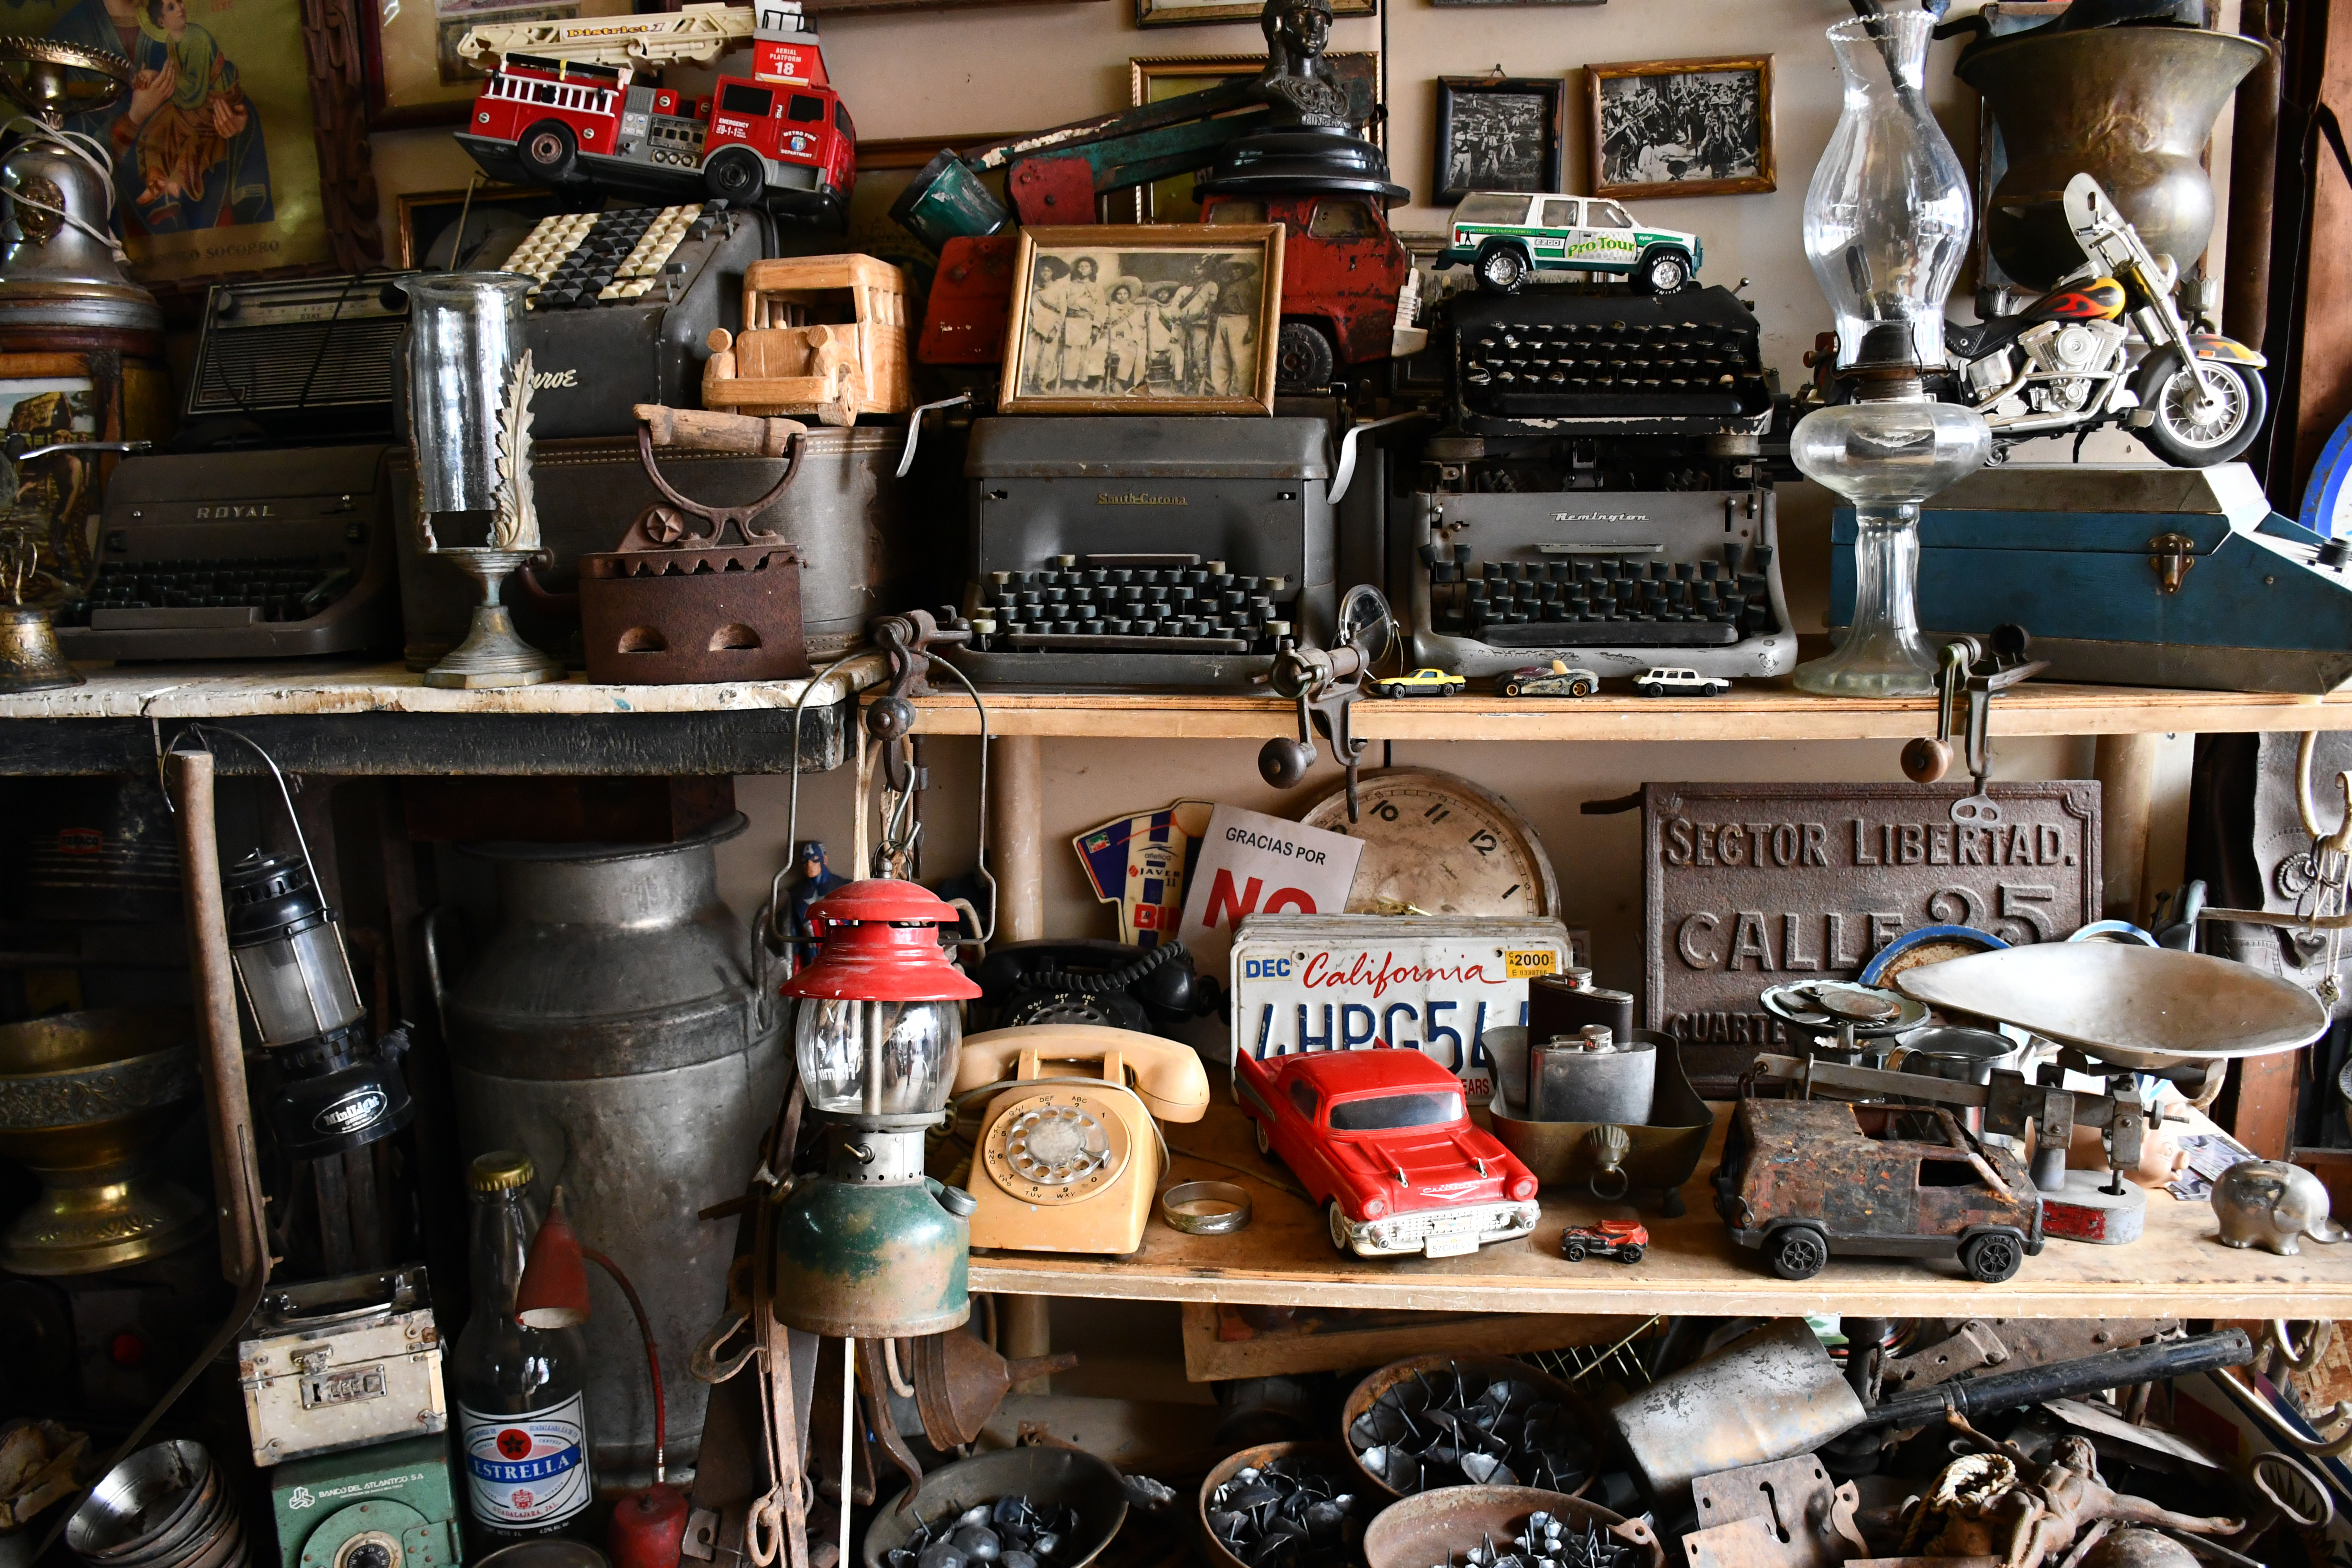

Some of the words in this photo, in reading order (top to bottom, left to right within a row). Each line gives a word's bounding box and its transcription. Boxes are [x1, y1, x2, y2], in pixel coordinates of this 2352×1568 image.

[568, 25, 648, 37] District
[651, 22, 665, 32] 1
[769, 53, 802, 63] PLATFORM
[776, 47, 797, 55] AERIAL
[775, 62, 794, 75] 18
[719, 117, 749, 128] EMERGENCY
[804, 131, 817, 142] FIRE
[781, 149, 812, 158] DEPARTMENT
[1568, 242, 1597, 259] Pro
[1597, 236, 1636, 253] Tour
[1484, 252, 1501, 276] NYLINT
[1652, 255, 1680, 267] NYLINT
[1097, 493, 1186, 504] Smith-Corona
[197, 505, 276, 519] ROYAL
[1550, 512, 1650, 523] Remington
[1369, 800, 1399, 821] 10
[1424, 803, 1450, 825] 11
[1226, 827, 1293, 856] GRACIAS
[1296, 847, 1326, 866] POR
[1468, 829, 1497, 856] 12
[1667, 818, 1828, 867] SECTOR
[1679, 910, 1904, 972] CALLE
[1515, 954, 1549, 966] 2000
[1246, 958, 1290, 978] DEC
[1303, 951, 1507, 999] California
[1671, 1012, 1786, 1043] CUARTE
[1255, 1001, 1529, 1075] 4HPG54
[1459, 1078, 1490, 1095] EARS
[1432, 1242, 1470, 1252] 57CHEVY
[474, 1455, 570, 1479] ESTRELLA
[318, 1487, 347, 1498] BANCO
[347, 1484, 363, 1493] DEL
[364, 1475, 408, 1489] ATLANTICO
